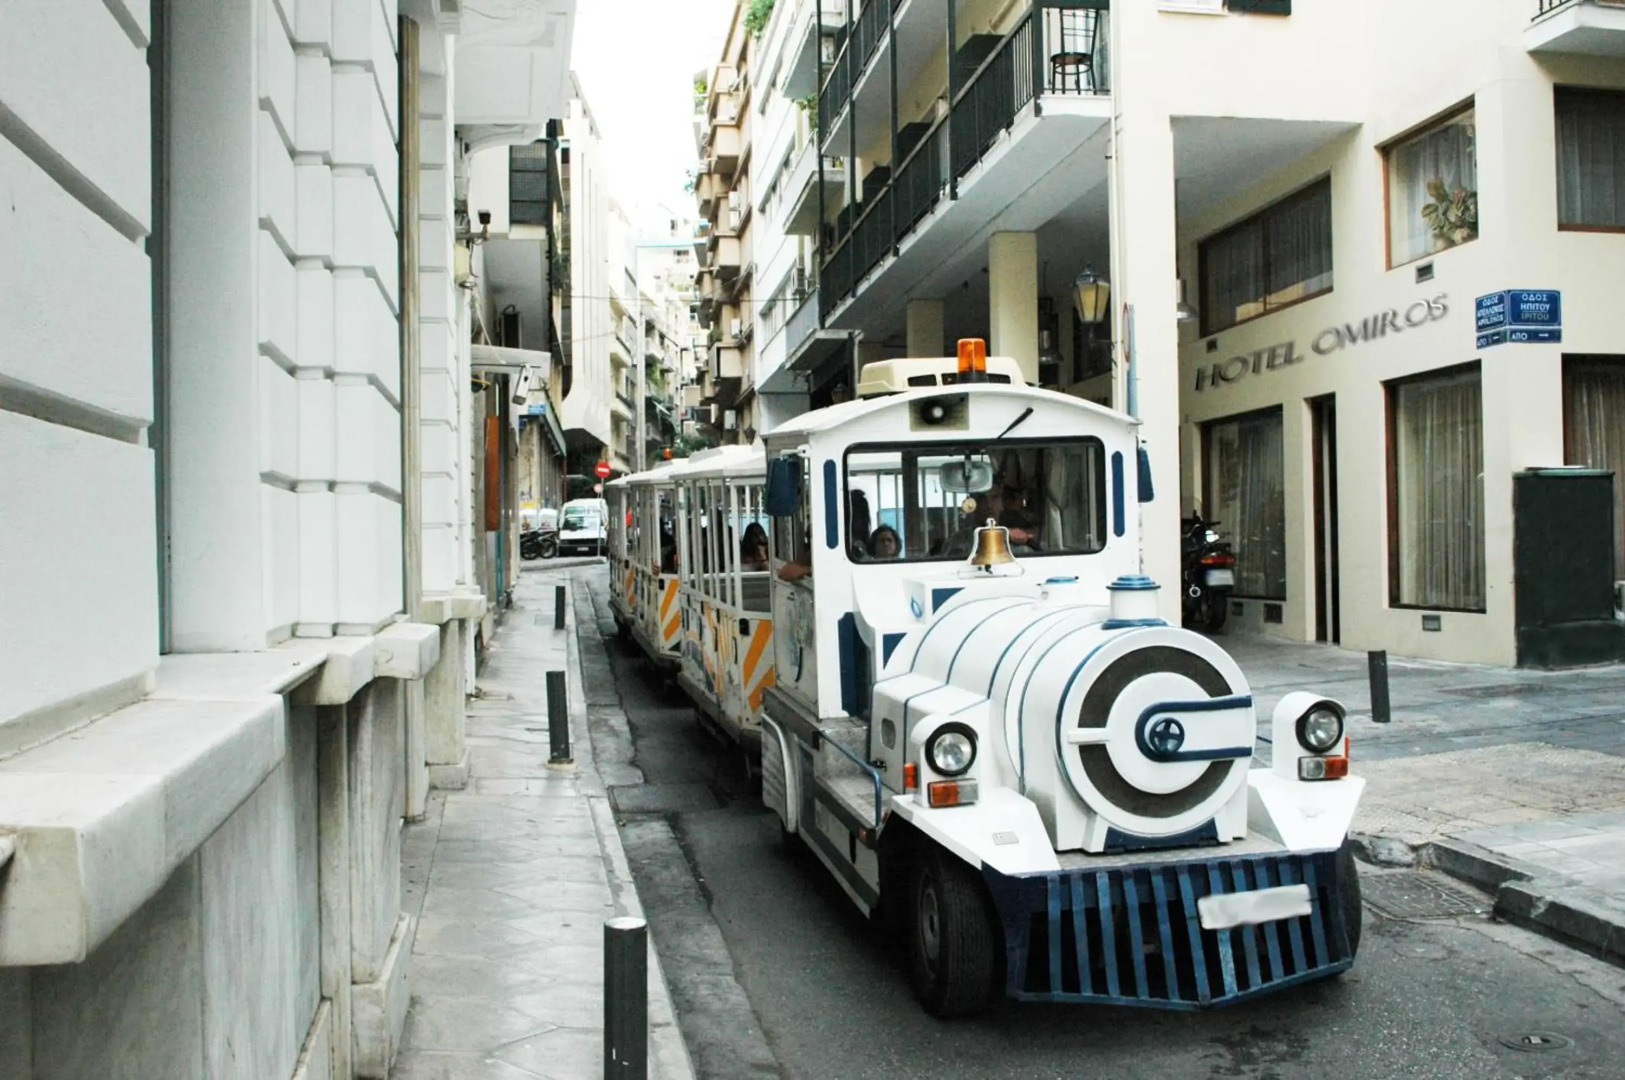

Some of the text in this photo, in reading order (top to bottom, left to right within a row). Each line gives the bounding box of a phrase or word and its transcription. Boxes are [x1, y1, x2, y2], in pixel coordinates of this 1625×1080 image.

[1521, 293, 1548, 302] ΟΔΟΣ
[1520, 302, 1550, 311] ΗΠΙΤΟΥ
[1511, 332, 1528, 340] ΑΠΟ
[1194, 292, 1449, 392] HOTEL OMIROS
